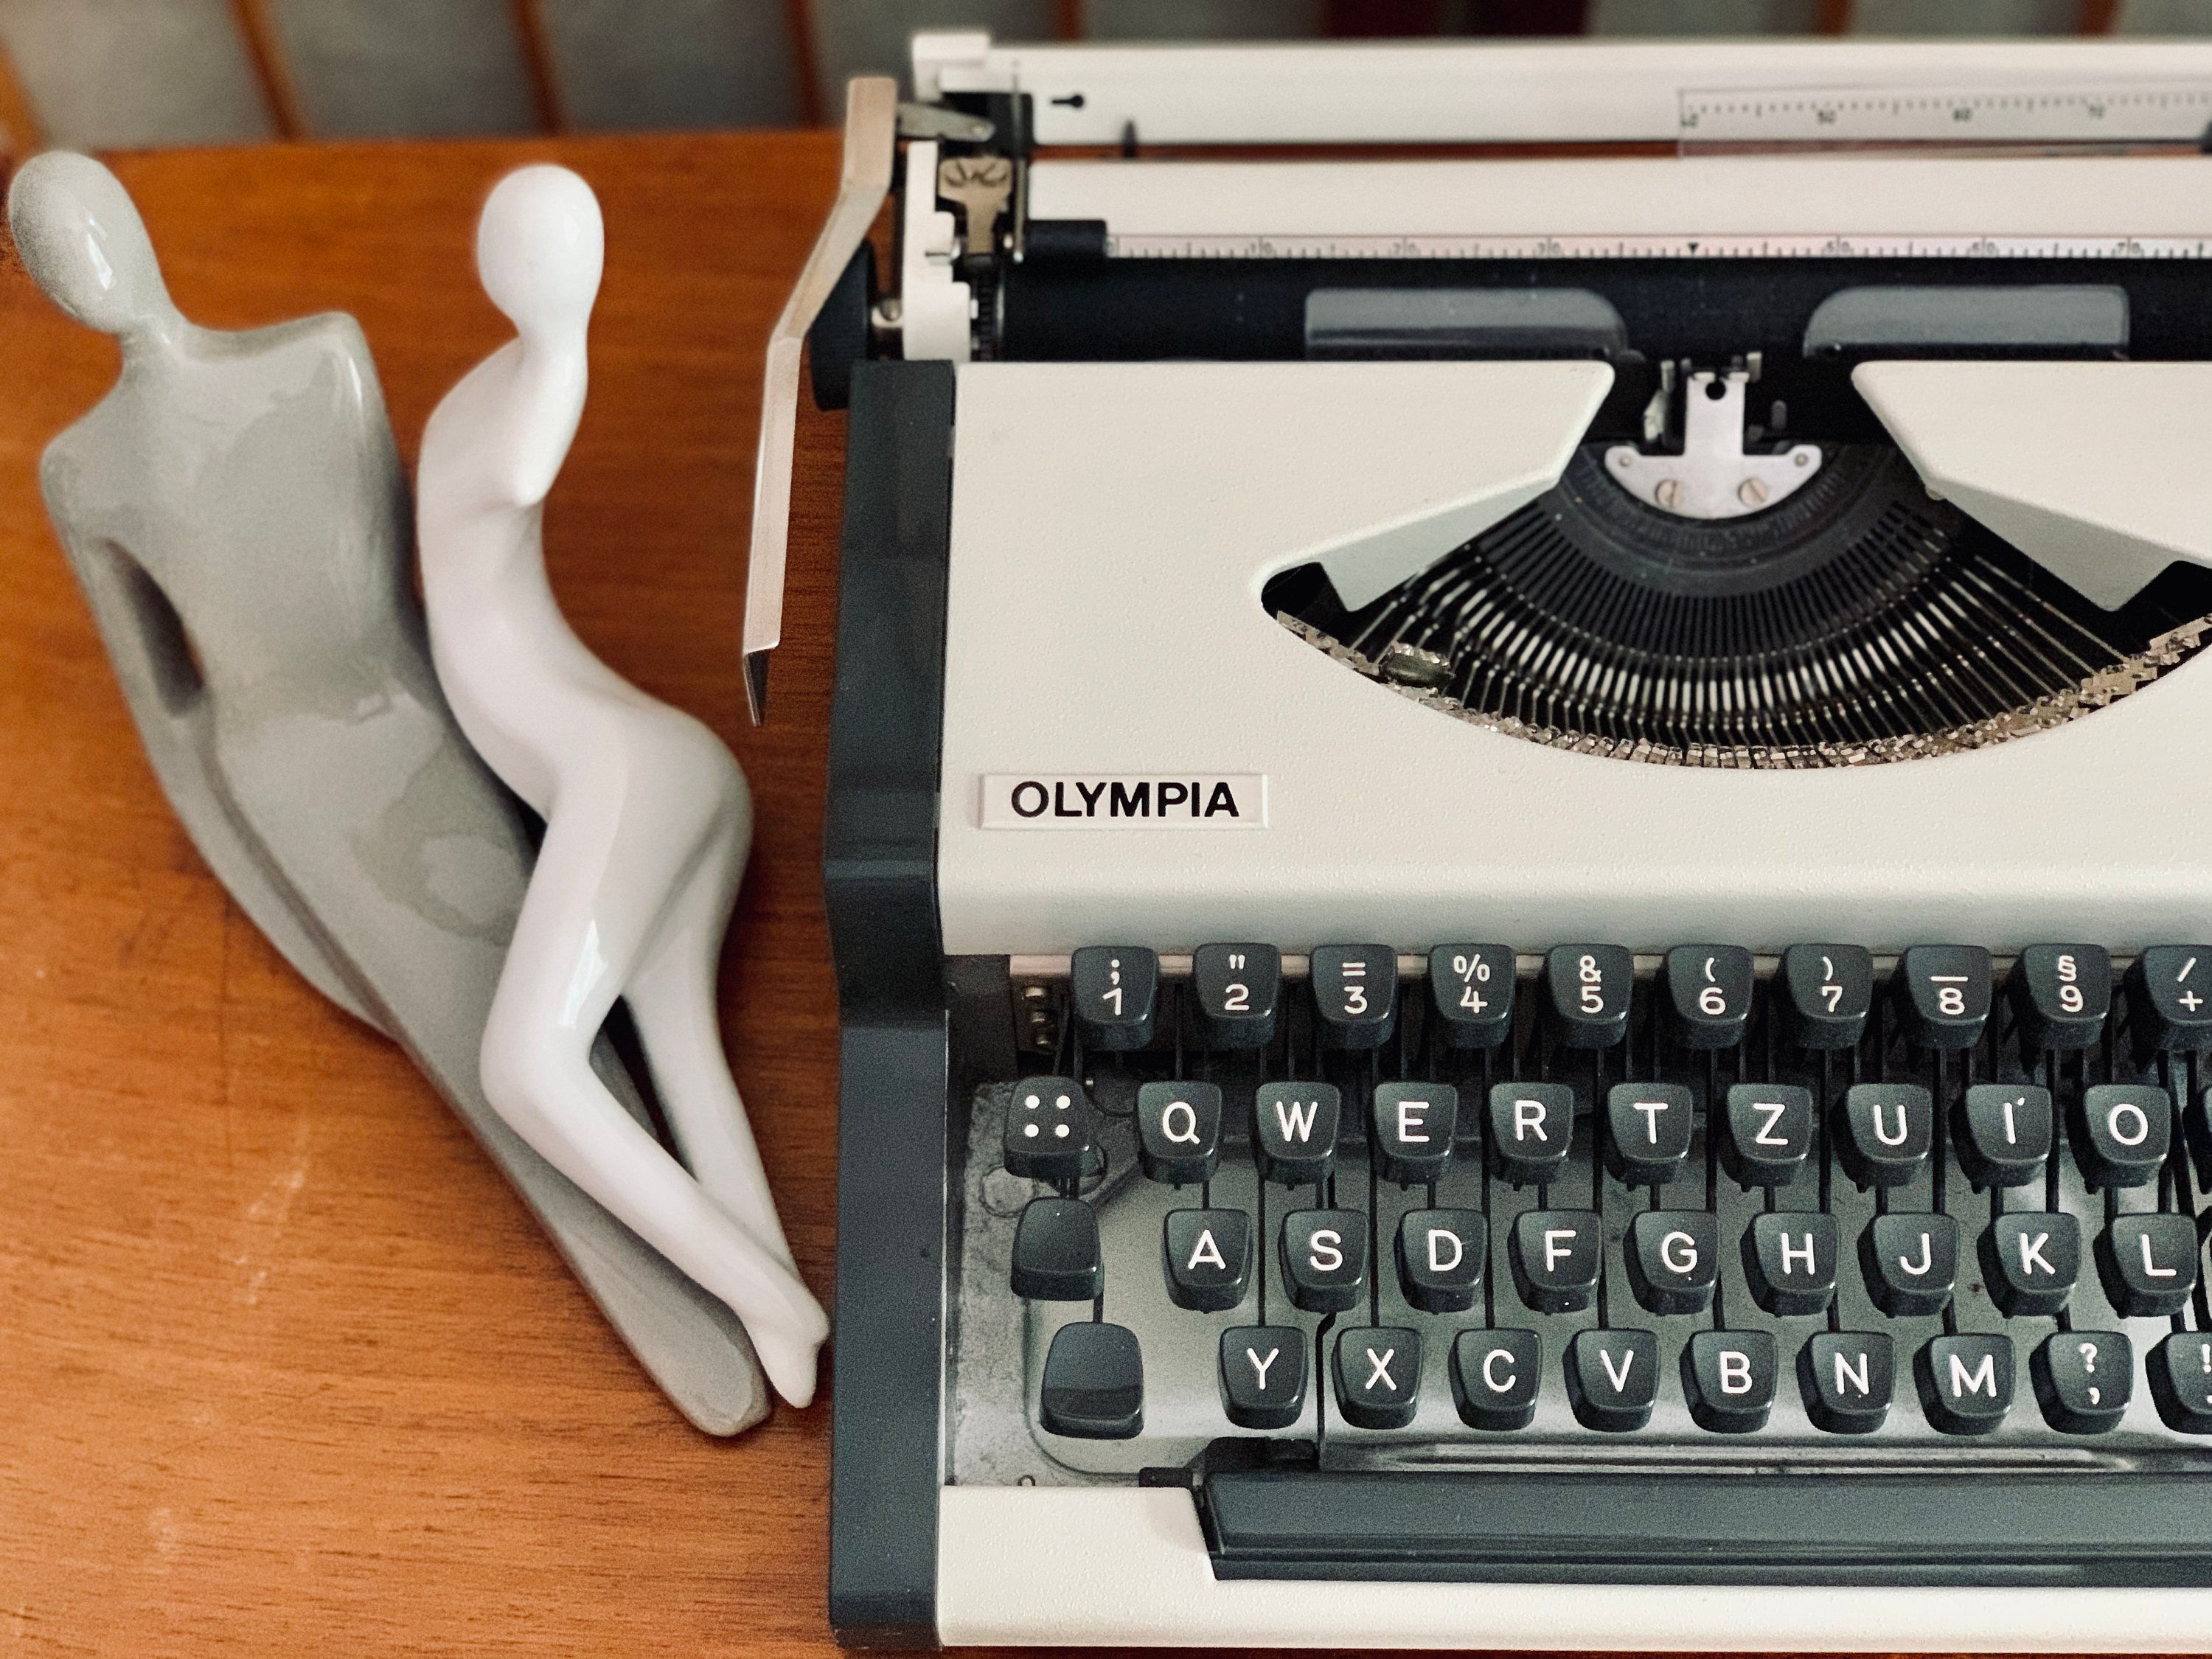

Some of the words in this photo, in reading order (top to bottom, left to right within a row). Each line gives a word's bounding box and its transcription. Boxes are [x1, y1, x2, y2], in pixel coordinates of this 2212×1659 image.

[1011, 781, 1240, 818] OLYMPIA
[1110, 959, 1120, 985] ;
[1228, 954, 1245, 970] "
[1342, 962, 1366, 976] =
[1453, 953, 1490, 983] %
[1579, 955, 1601, 983] &
[1705, 957, 1716, 982] (
[1822, 956, 1834, 981] )
[2058, 955, 2077, 982] §
[2177, 957, 2197, 982] /
[1102, 987, 1122, 1016] 1
[1224, 984, 1250, 1011] 2
[1343, 986, 1368, 1015] 3
[1459, 986, 1488, 1014] 4
[1581, 985, 1604, 1014] 5
[1699, 987, 1726, 1015] 6
[1821, 985, 1843, 1012] 7
[1938, 987, 1965, 1015] 8
[2060, 985, 2084, 1012] 9
[2179, 990, 2203, 1012] +
[1162, 1101, 1200, 1144] Q
[1276, 1100, 1318, 1143] W
[1397, 1101, 1430, 1143] E
[1514, 1099, 1548, 1141] R
[1632, 1102, 1669, 1144] T
[1753, 1102, 1789, 1145] Z
[1872, 1104, 1907, 1146] U
[2107, 1103, 2149, 1146] O
[1187, 1229, 1226, 1270] A
[1310, 1229, 1343, 1271] S
[1427, 1228, 1463, 1272] D
[1544, 1229, 1576, 1272] F
[1660, 1231, 1698, 1273] G
[1779, 1232, 1815, 1276] H
[1899, 1232, 1932, 1276] J
[2018, 1232, 2056, 1275] K
[2139, 1234, 2177, 1276] L
[1246, 1347, 1279, 1391] Y
[1365, 1348, 1397, 1391] X
[1482, 1349, 1517, 1393] C
[1599, 1349, 1634, 1393] V
[1719, 1351, 1753, 1394] B
[1834, 1352, 1870, 1395] N
[1948, 1354, 1997, 1398] M
[2079, 1342, 2098, 1374] ?
[2200, 1343, 2212, 1374] !
[2088, 1387, 2101, 1405] ,
